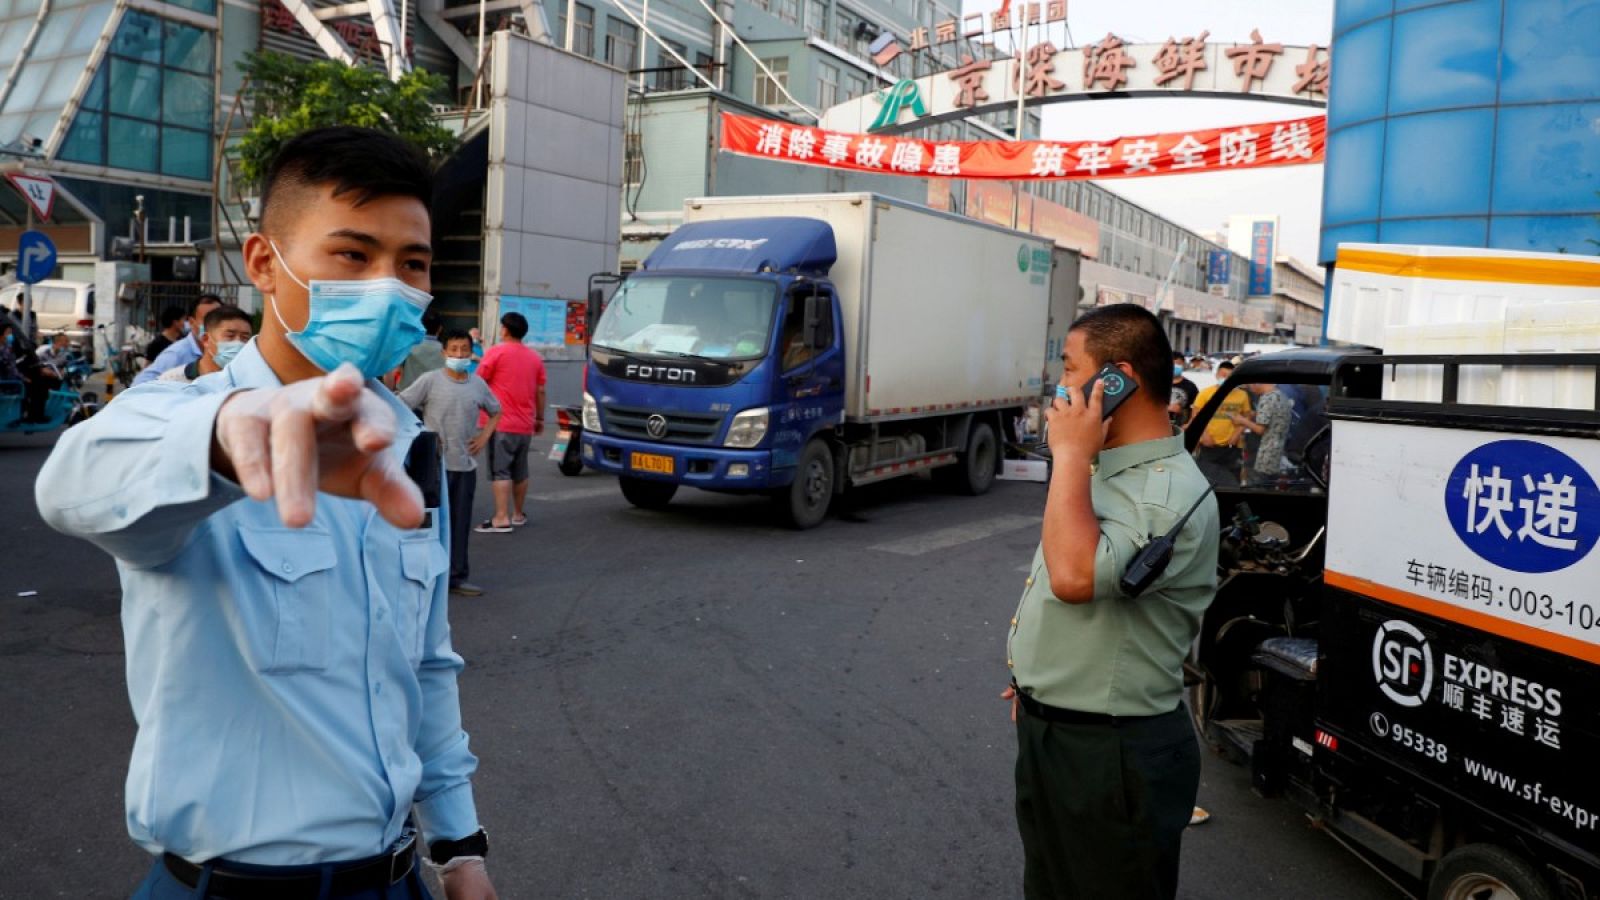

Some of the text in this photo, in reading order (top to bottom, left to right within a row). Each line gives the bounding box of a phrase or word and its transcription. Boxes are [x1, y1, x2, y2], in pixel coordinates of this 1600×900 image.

[756, 122, 1313, 177] 消除事故隐患 筑牢安全防线
[626, 364, 696, 382] FOTON
[1462, 463, 1578, 551] 快递
[1442, 681, 1561, 749] 顺丰速运
[1443, 653, 1562, 716] EXPRESS
[1392, 723, 1600, 830] 95338 www.sf-expr
